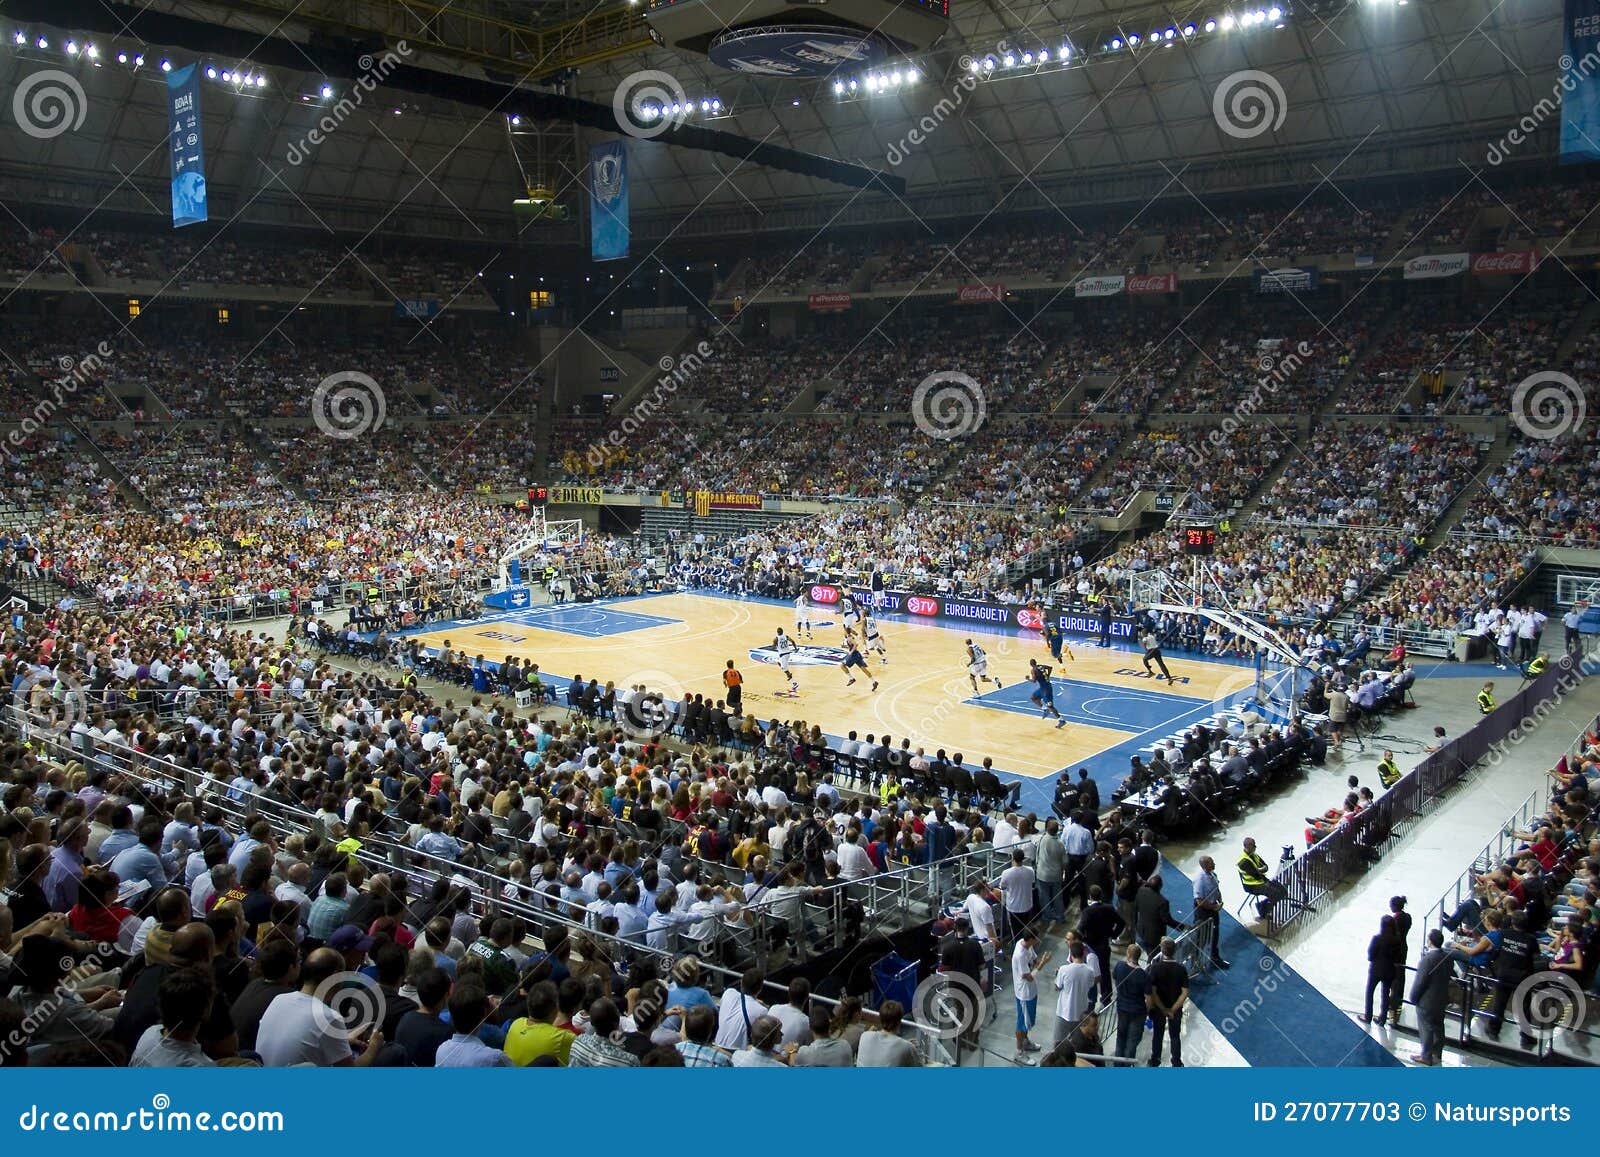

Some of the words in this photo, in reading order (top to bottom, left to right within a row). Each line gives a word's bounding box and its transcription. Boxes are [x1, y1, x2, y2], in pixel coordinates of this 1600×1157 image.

[562, 488, 601, 503] DRACS
[1156, 498, 1173, 506] BAR
[822, 589, 837, 601] TV
[920, 600, 935, 613] TV
[945, 603, 1009, 622] EUROLEAGUE.TV
